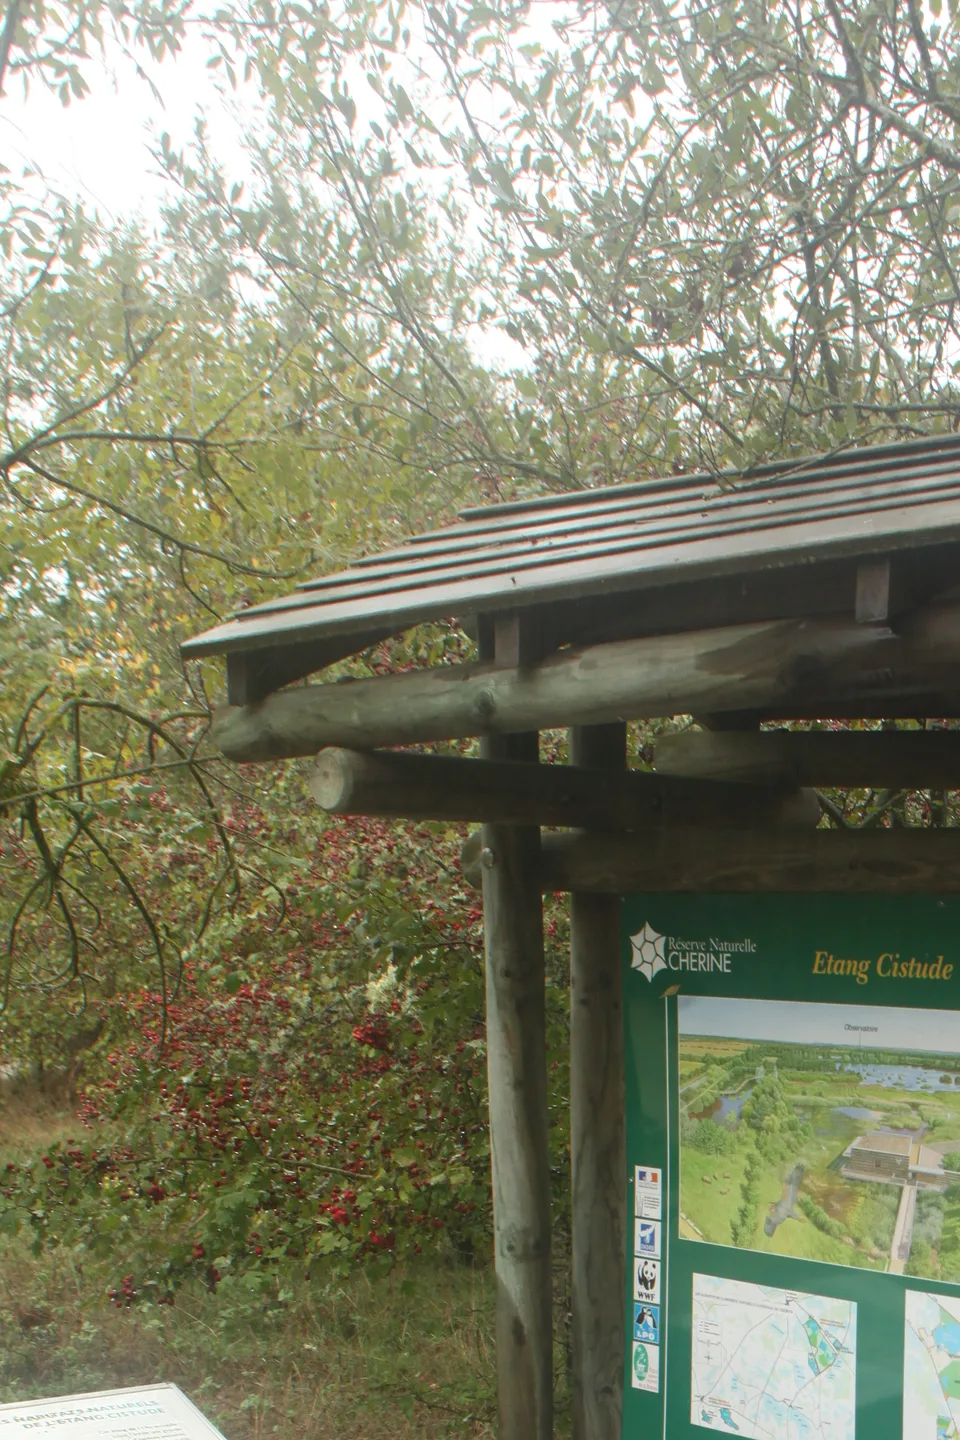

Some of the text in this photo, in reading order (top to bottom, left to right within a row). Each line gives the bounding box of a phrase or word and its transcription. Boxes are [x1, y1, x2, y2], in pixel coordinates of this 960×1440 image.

[669, 936, 756, 953] Réserve Naturelle
[668, 951, 731, 973] CHERINE
[812, 950, 953, 984] Etang Cistude
[844, 1023, 878, 1033] Observatoire
[638, 1291, 655, 1301] WWF
[637, 1330, 655, 1340] LPO
[23, 1421, 43, 1430] DE
[108, 1406, 166, 1420] CISTUDE
